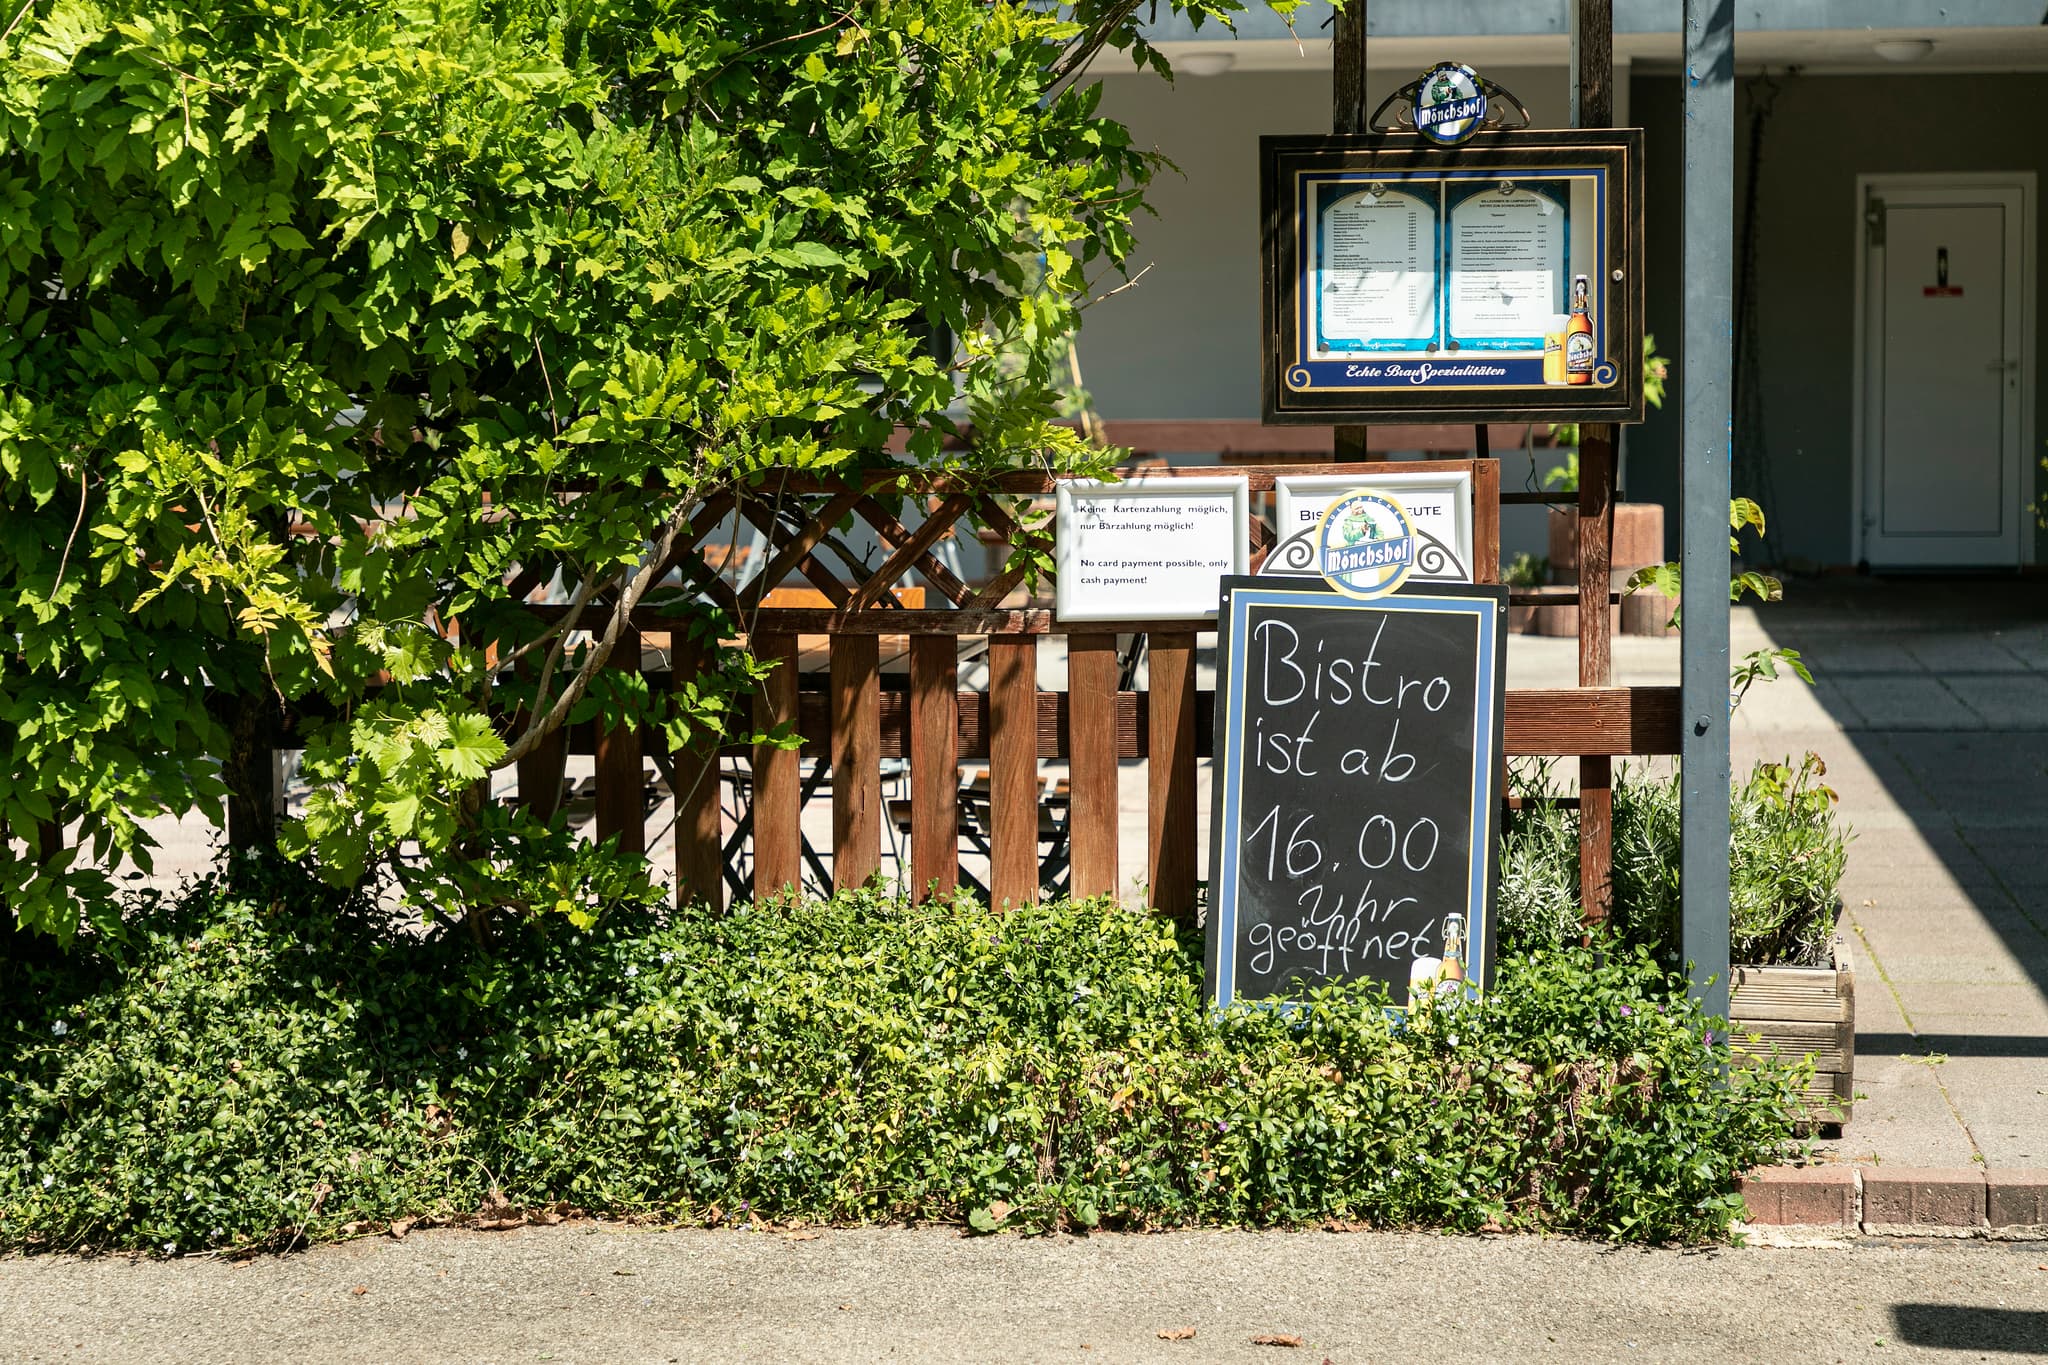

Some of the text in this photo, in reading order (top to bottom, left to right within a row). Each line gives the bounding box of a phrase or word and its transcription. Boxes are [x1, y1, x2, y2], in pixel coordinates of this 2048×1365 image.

[1421, 98, 1481, 126] Mönchshof
[1345, 363, 1507, 385] Echte BrauSpezialitäten
[1080, 504, 1228, 515] Keine Kartenzahlung möglich,
[1300, 510, 1324, 521] BIS
[1325, 496, 1405, 529] KULMBACHER
[1080, 521, 1194, 532] nur Barzahlung möglich!
[1080, 559, 1228, 569] No card payment possible, only
[1328, 539, 1409, 572] Mönchshof
[1080, 576, 1148, 586] cash payment!
[1253, 614, 1452, 712] Bistro
[1256, 709, 1417, 784] ist ab
[1298, 879, 1418, 927] Uhr
[1249, 913, 1435, 976] geöffnet
